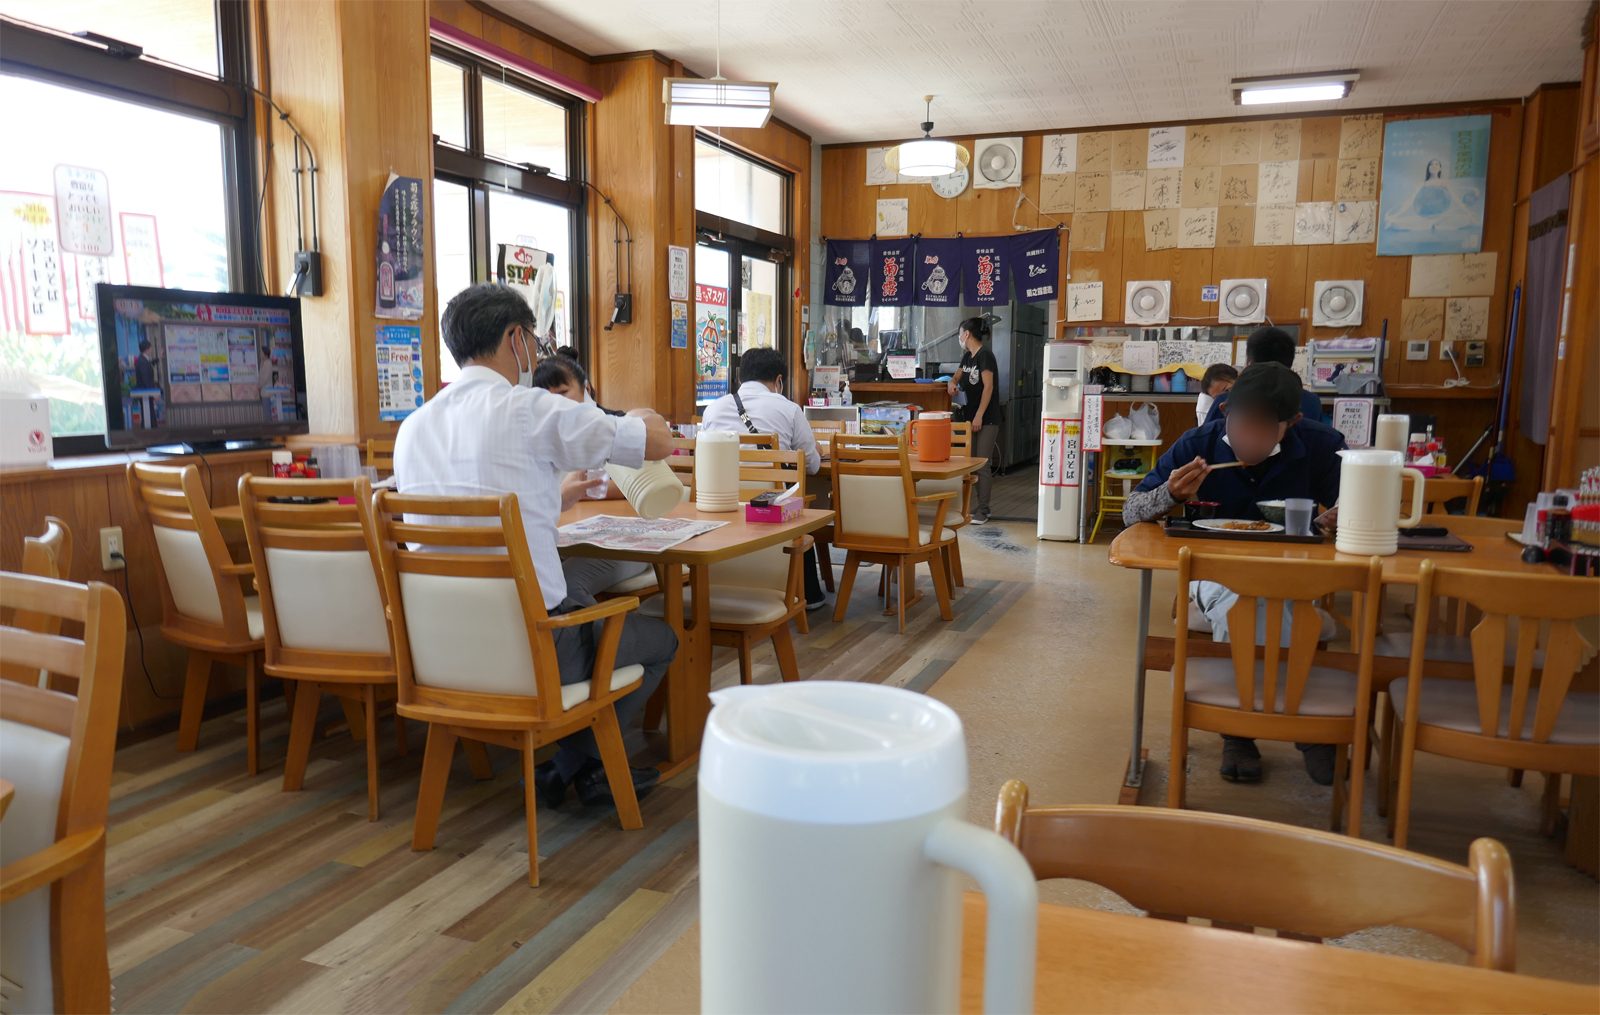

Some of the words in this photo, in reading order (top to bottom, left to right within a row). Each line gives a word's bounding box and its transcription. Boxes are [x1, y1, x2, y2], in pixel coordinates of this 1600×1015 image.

[391, 352, 409, 362] Free
[1047, 439, 1056, 479] ソーキそば
[1066, 439, 1077, 479] 宮古そば
